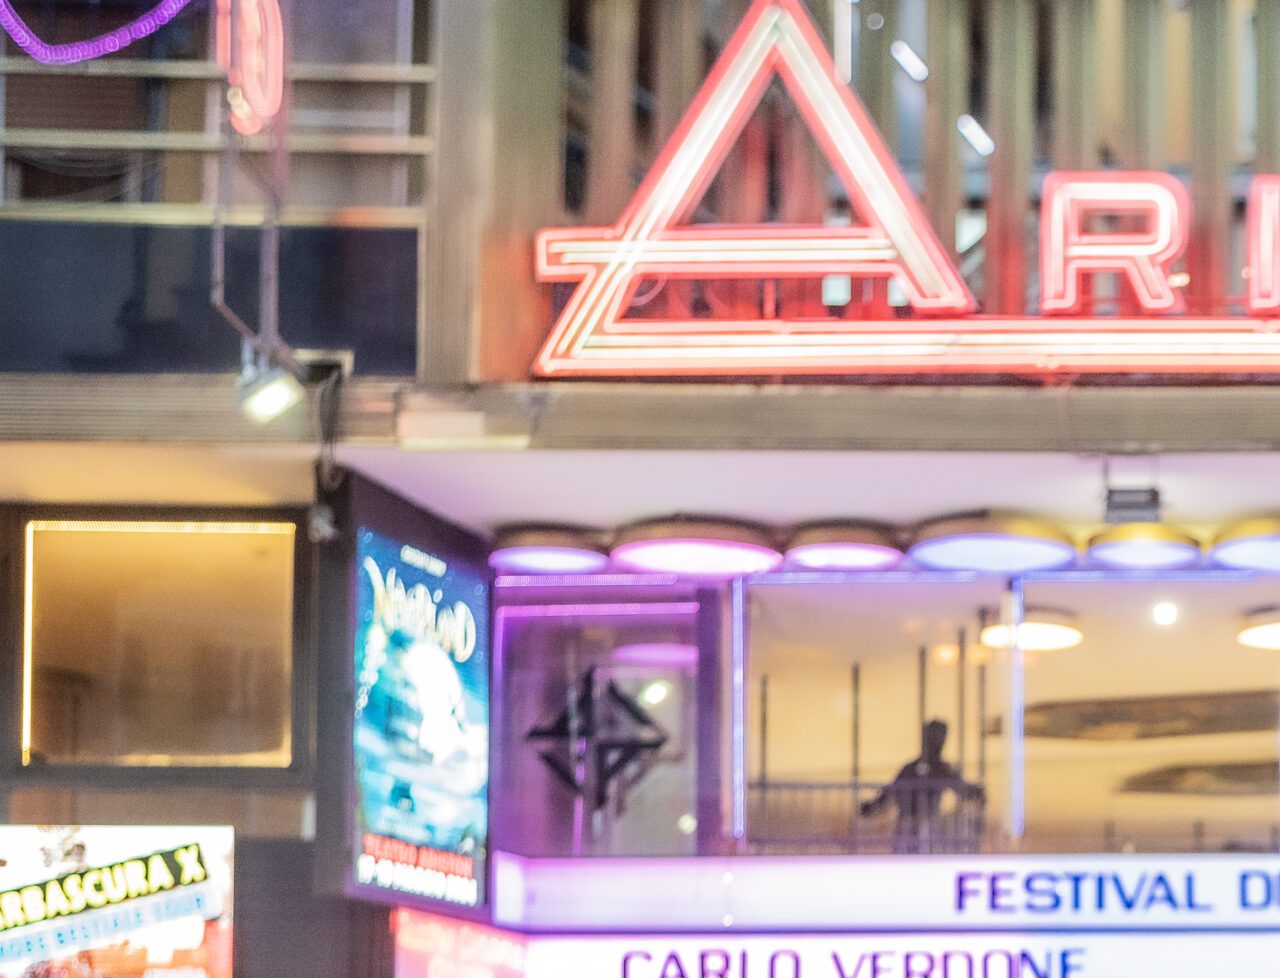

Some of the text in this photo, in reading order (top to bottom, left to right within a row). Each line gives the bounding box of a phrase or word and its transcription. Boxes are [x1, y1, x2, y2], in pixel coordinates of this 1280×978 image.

[0, 843, 207, 931] RBASCURA X
[954, 870, 1212, 913] FESTIVAL
